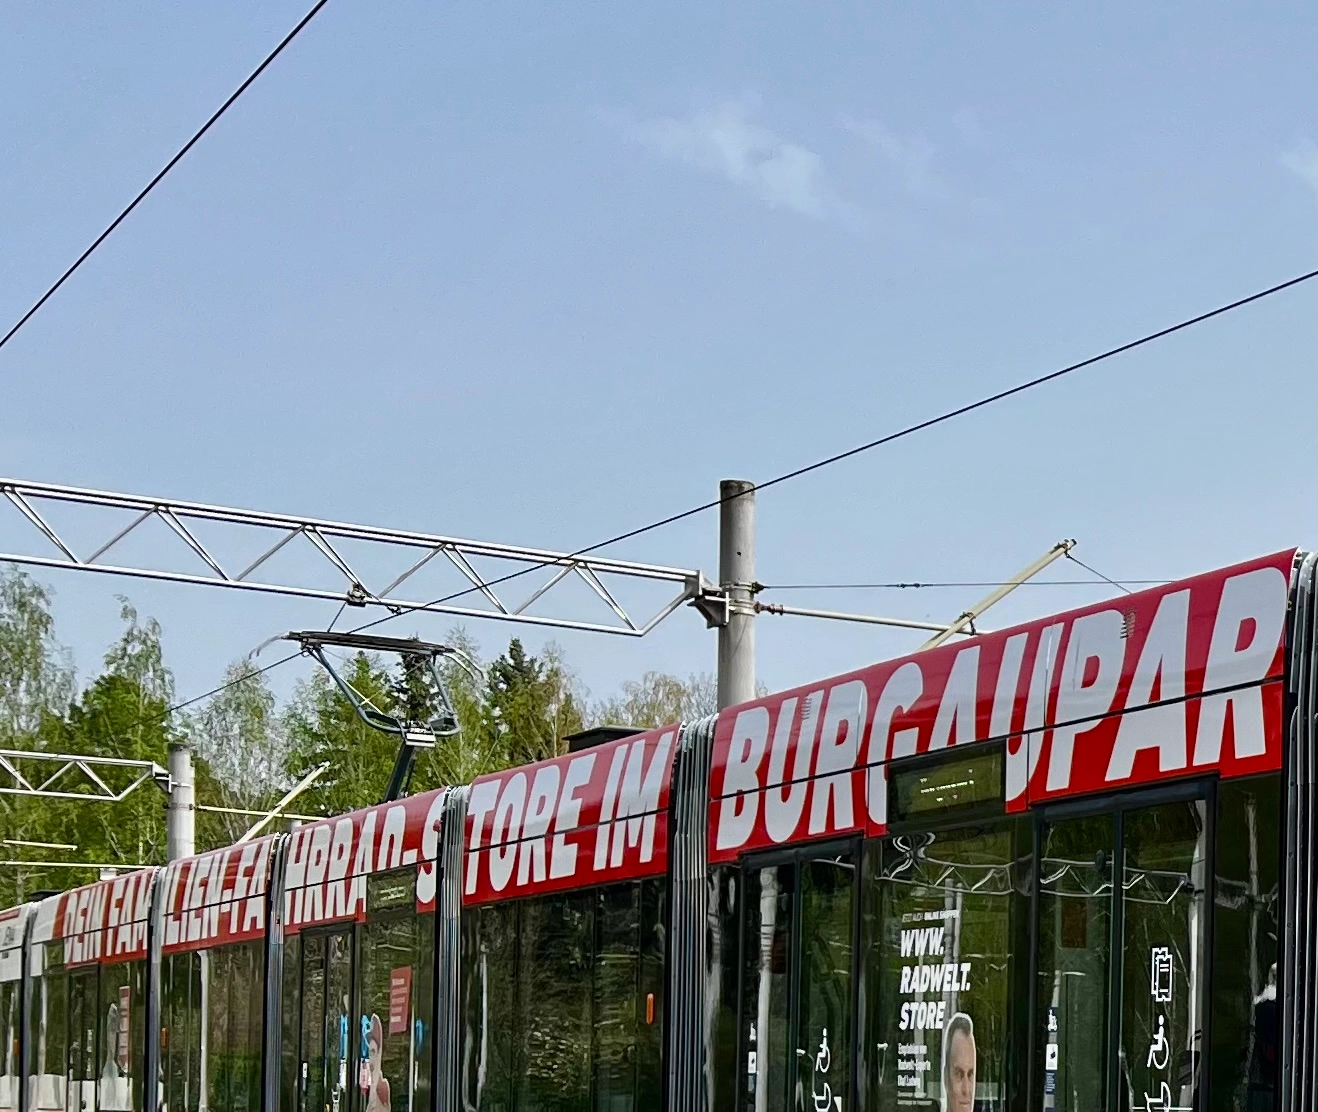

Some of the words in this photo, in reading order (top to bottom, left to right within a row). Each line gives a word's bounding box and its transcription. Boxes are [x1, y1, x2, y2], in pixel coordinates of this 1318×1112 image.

[63, 881, 107, 964] DEIN
[593, 731, 675, 871] IM
[900, 927, 945, 957] WWW.
[899, 962, 972, 994] RADWELT.
[898, 1001, 947, 1030] STORE
